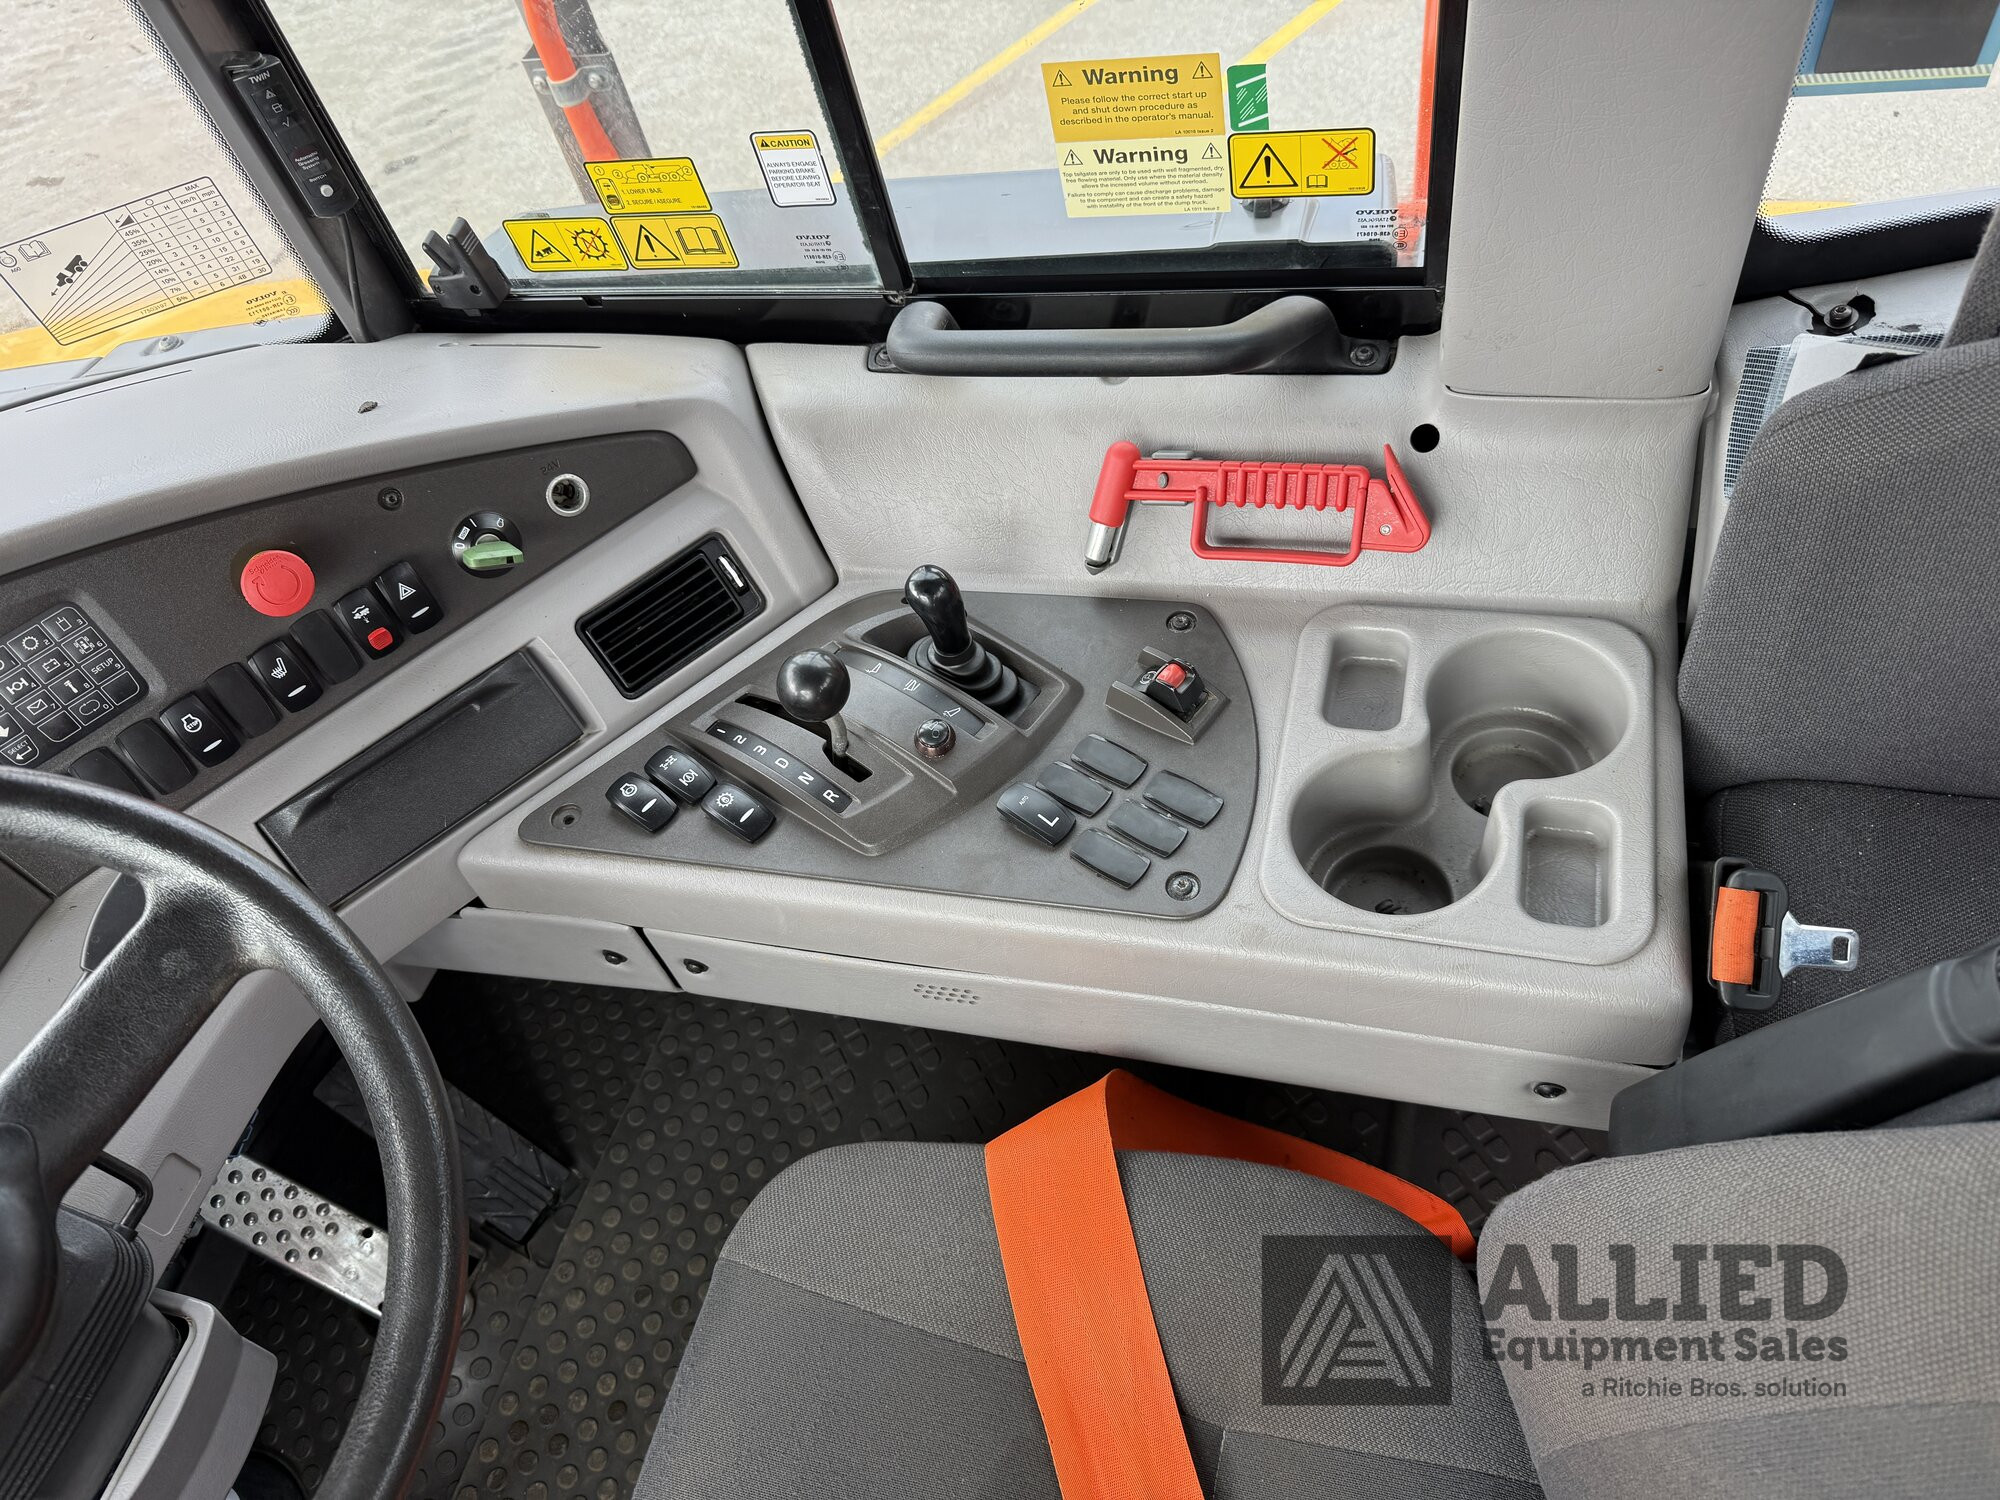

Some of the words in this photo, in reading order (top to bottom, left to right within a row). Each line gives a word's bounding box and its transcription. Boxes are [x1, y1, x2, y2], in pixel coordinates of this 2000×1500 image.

[248, 70, 270, 84] TWIN
[1082, 66, 1178, 85] Warning
[1061, 96, 1090, 105] Please
[1093, 95, 1118, 103] follow
[1138, 93, 1169, 101] correct
[1195, 91, 1207, 99] up
[1113, 104, 1136, 112] down
[1139, 103, 1184, 113] procedure
[1060, 117, 1102, 125] described
[1132, 113, 1176, 123] operator's
[1179, 111, 1213, 119] manual.
[770, 139, 810, 147] CAUTION
[1093, 147, 1188, 164] Warning
[179, 196, 197, 205] km/h
[202, 190, 216, 198] mph
[124, 228, 141, 237] 45%
[131, 238, 147, 247] 35%
[139, 248, 155, 257] 25%
[146, 258, 162, 266] 20%
[154, 268, 169, 276] 14%
[161, 277, 176, 285] 10%
[170, 286, 181, 294] 7%
[176, 295, 188, 303] 5%
[540, 459, 561, 475] 24V
[91, 657, 114, 675] SETUP
[733, 734, 747, 744] 2
[7, 740, 29, 755] SELECT
[753, 745, 767, 756] 3
[775, 757, 789, 769] D
[798, 771, 814, 785] N
[822, 789, 839, 803] R
[1037, 813, 1060, 828] L
